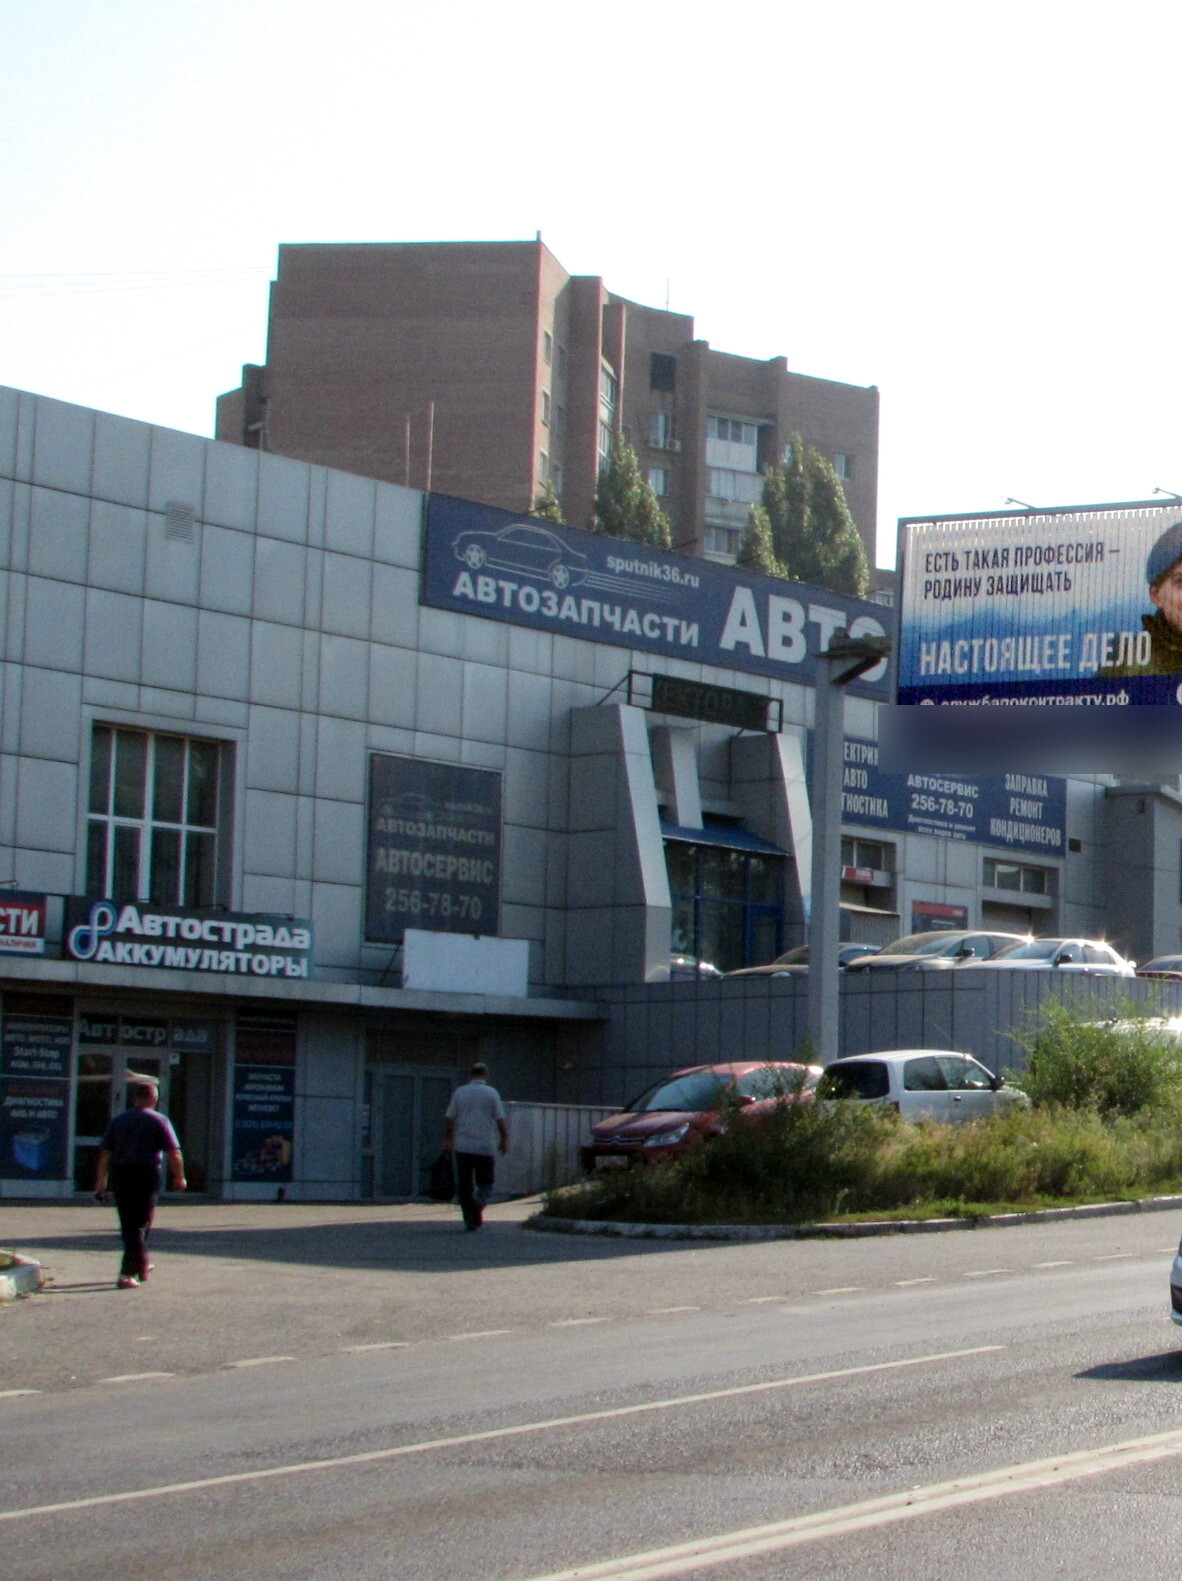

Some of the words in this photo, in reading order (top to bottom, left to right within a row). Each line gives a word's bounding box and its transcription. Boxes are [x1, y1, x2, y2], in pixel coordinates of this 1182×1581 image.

[606, 555, 700, 588] sputnik36.ru
[926, 552, 960, 573] ЕСТЬ
[965, 548, 1009, 570] ТАКАЯ
[1014, 542, 1104, 567] ПРОФЕССИЯ
[924, 576, 982, 600] РОДИНУ
[986, 571, 1073, 596] ЗАЩИЩАТЬ
[453, 572, 700, 648] АВТОЗАПЧАСТИ
[920, 635, 1072, 675] НАСТОЯЩЕЕ
[1079, 630, 1152, 673] ДЕЛО
[844, 741, 879, 766] ЕКТРИ
[843, 767, 868, 790] АВТО
[907, 774, 980, 799] АВТОСЕРВИС
[1005, 773, 1048, 798] ЗАПРАВКА
[841, 791, 888, 818] ГНОСТИКА
[911, 793, 974, 819] 256-78-70
[1010, 797, 1044, 820] РЕМОНТ
[990, 817, 1062, 848] КОНДИЦИОНЕРОВ
[376, 847, 494, 884] АВТОСЕРВИС
[385, 886, 483, 920] 256-78-70
[115, 905, 311, 950] Автострада
[96, 941, 308, 978] АККУМУЛЯТОРЫ
